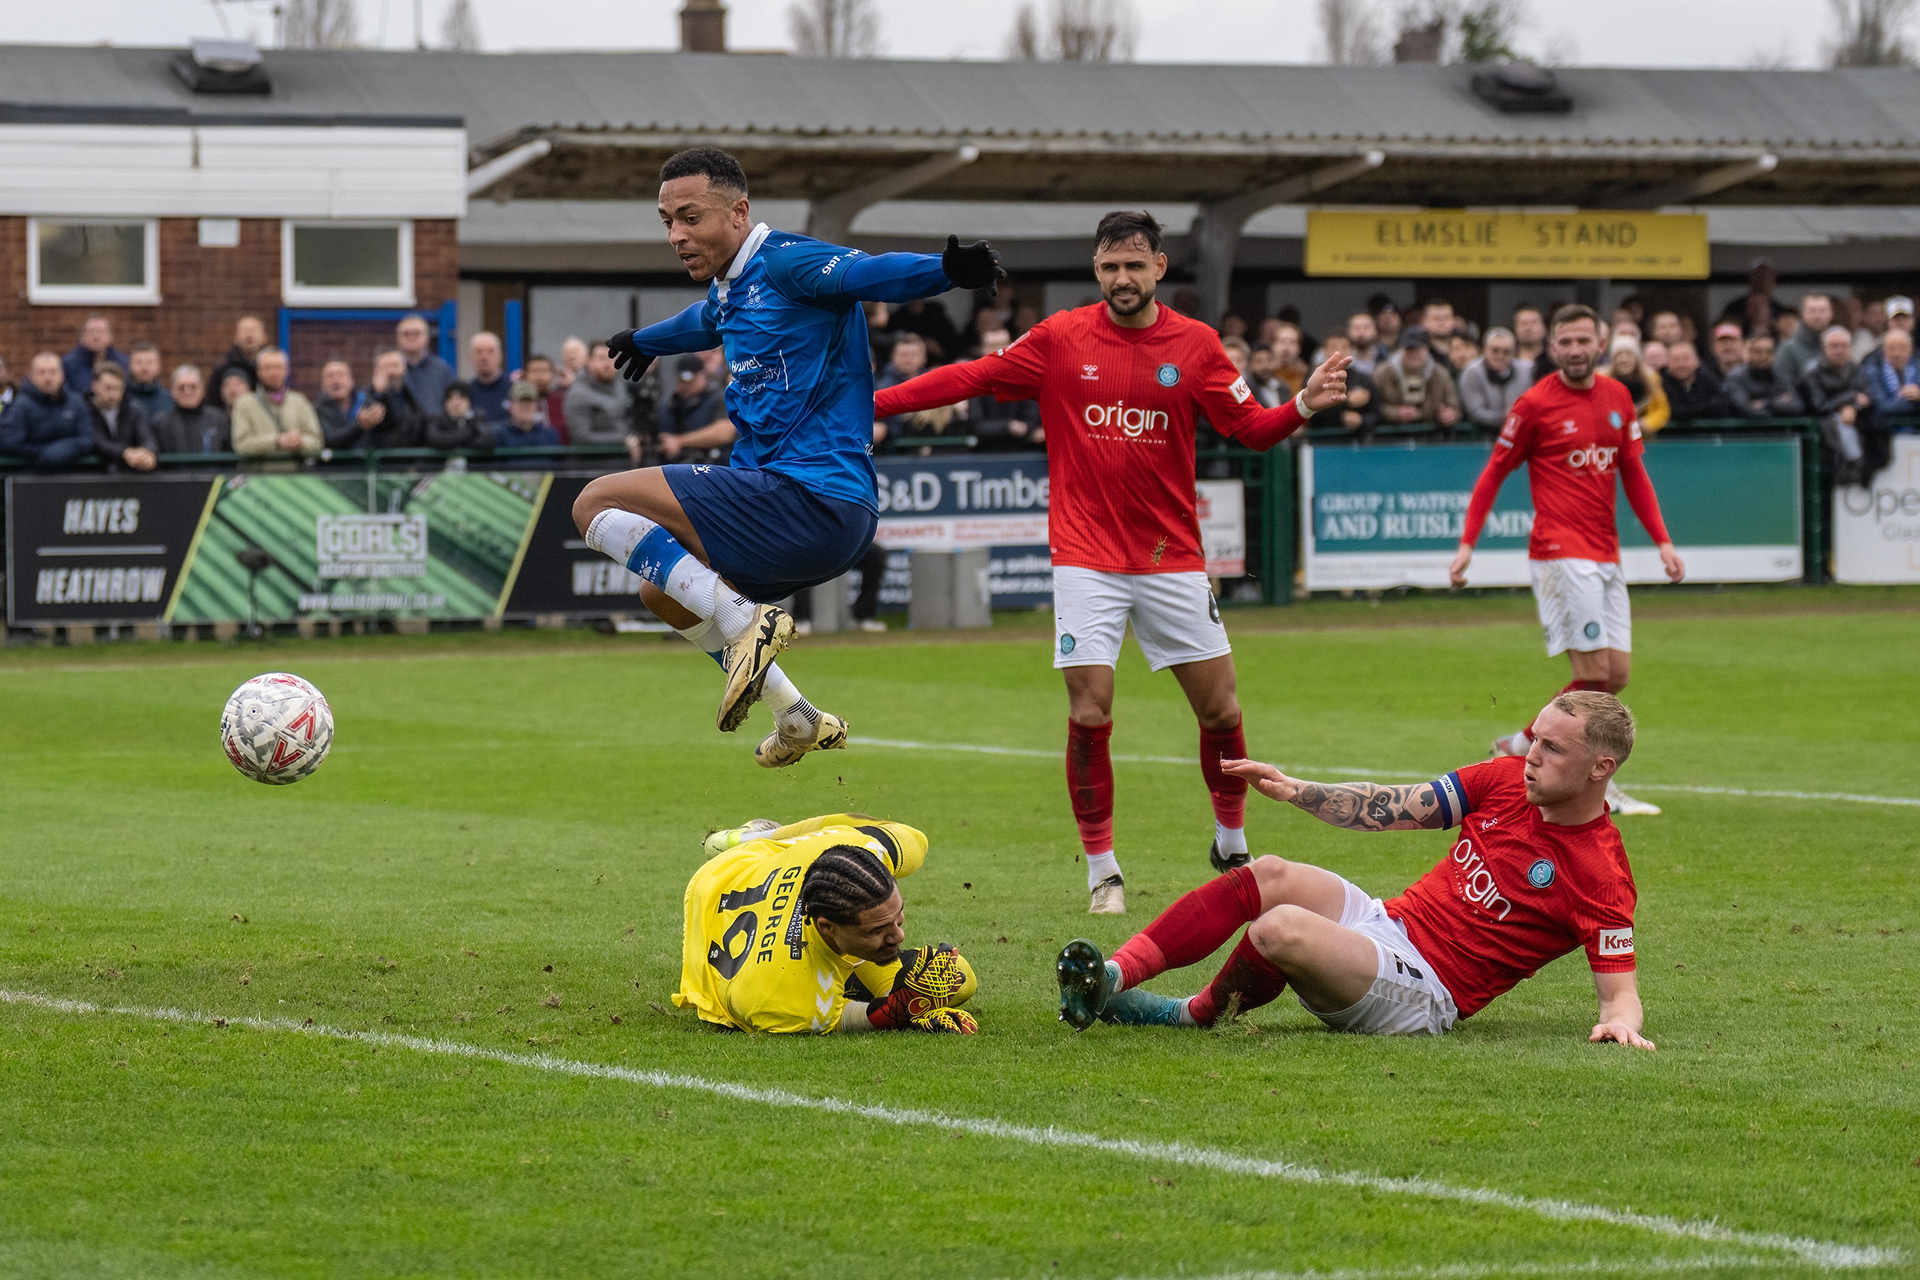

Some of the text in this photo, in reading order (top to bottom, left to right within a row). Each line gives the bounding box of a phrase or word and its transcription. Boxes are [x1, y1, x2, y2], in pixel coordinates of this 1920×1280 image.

[1377, 220, 1638, 249] ELMSLIE STAND
[1085, 400, 1168, 437] origin
[949, 470, 1049, 510] Timbe
[1320, 493, 1383, 513] GROUP
[1401, 492, 1471, 512] WATFO
[1844, 485, 1920, 522] Ope
[63, 498, 140, 534] HAYES
[1322, 514, 1379, 540] AND
[1381, 513, 1464, 539] RUISLI
[327, 524, 418, 552] GOALS
[36, 567, 167, 604] HEATHROW
[1453, 838, 1511, 921] origin
[707, 867, 782, 981] 19
[756, 866, 802, 964] GEORGE
